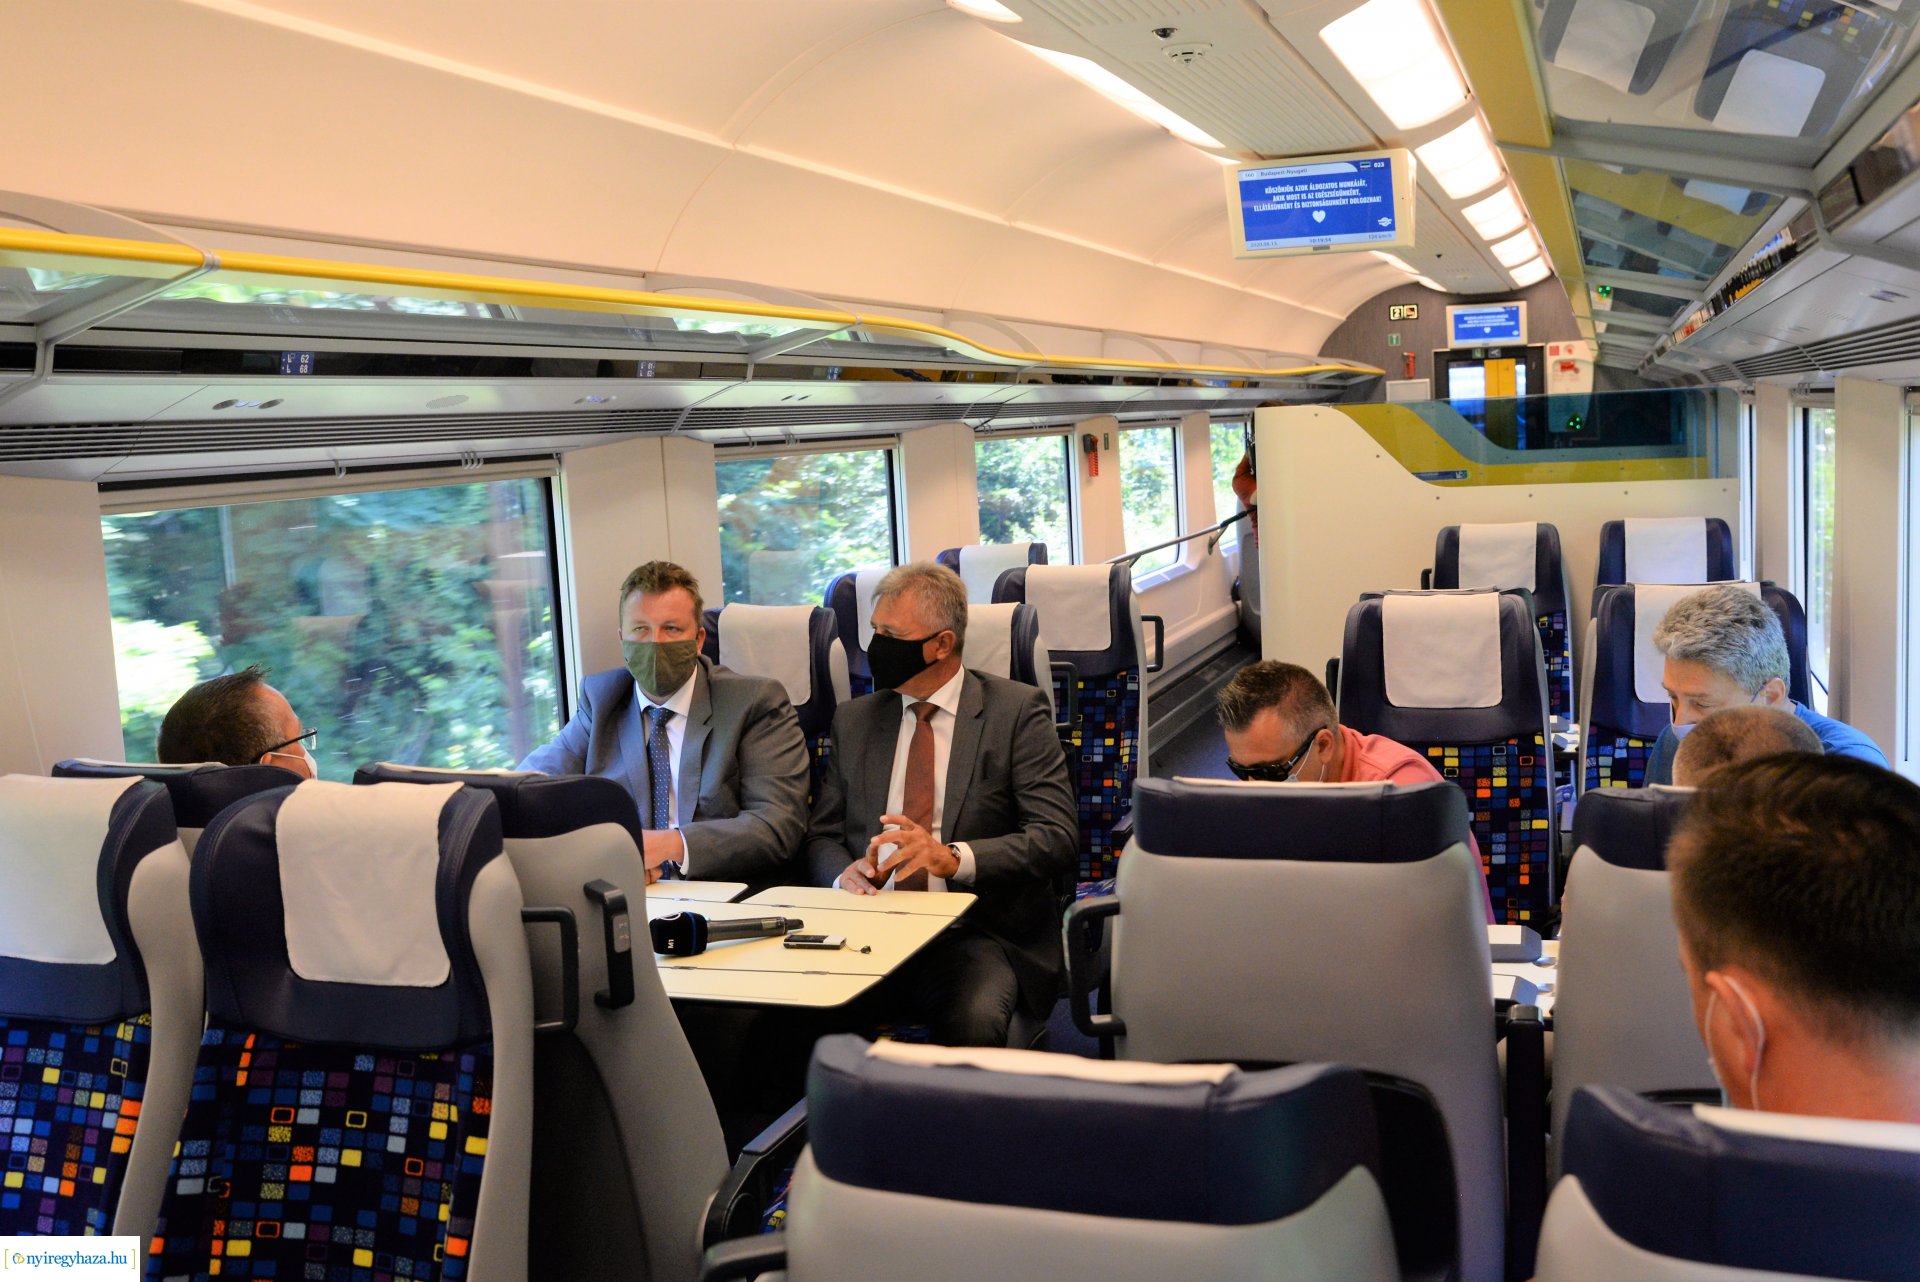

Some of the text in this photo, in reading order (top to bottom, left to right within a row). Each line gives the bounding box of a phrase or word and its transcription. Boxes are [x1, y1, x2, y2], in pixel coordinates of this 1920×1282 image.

[1264, 184, 1294, 194] KÖSZÖNJÜK
[1295, 184, 1308, 192] AZOK
[1309, 181, 1338, 191] ÁLDOZATOS
[1272, 194, 1285, 202] AKIK
[1286, 193, 1300, 201] MOST
[1301, 192, 1307, 200] IS
[1253, 195, 1382, 212] ELLÁTÁSUNKÉRT ÉS BIZTONSÁGUNKÉRT DOLGOZNAK!
[1393, 308, 1400, 318] 2
[300, 354, 309, 363] 62
[299, 364, 309, 374] 68
[667, 939, 674, 949] M1
